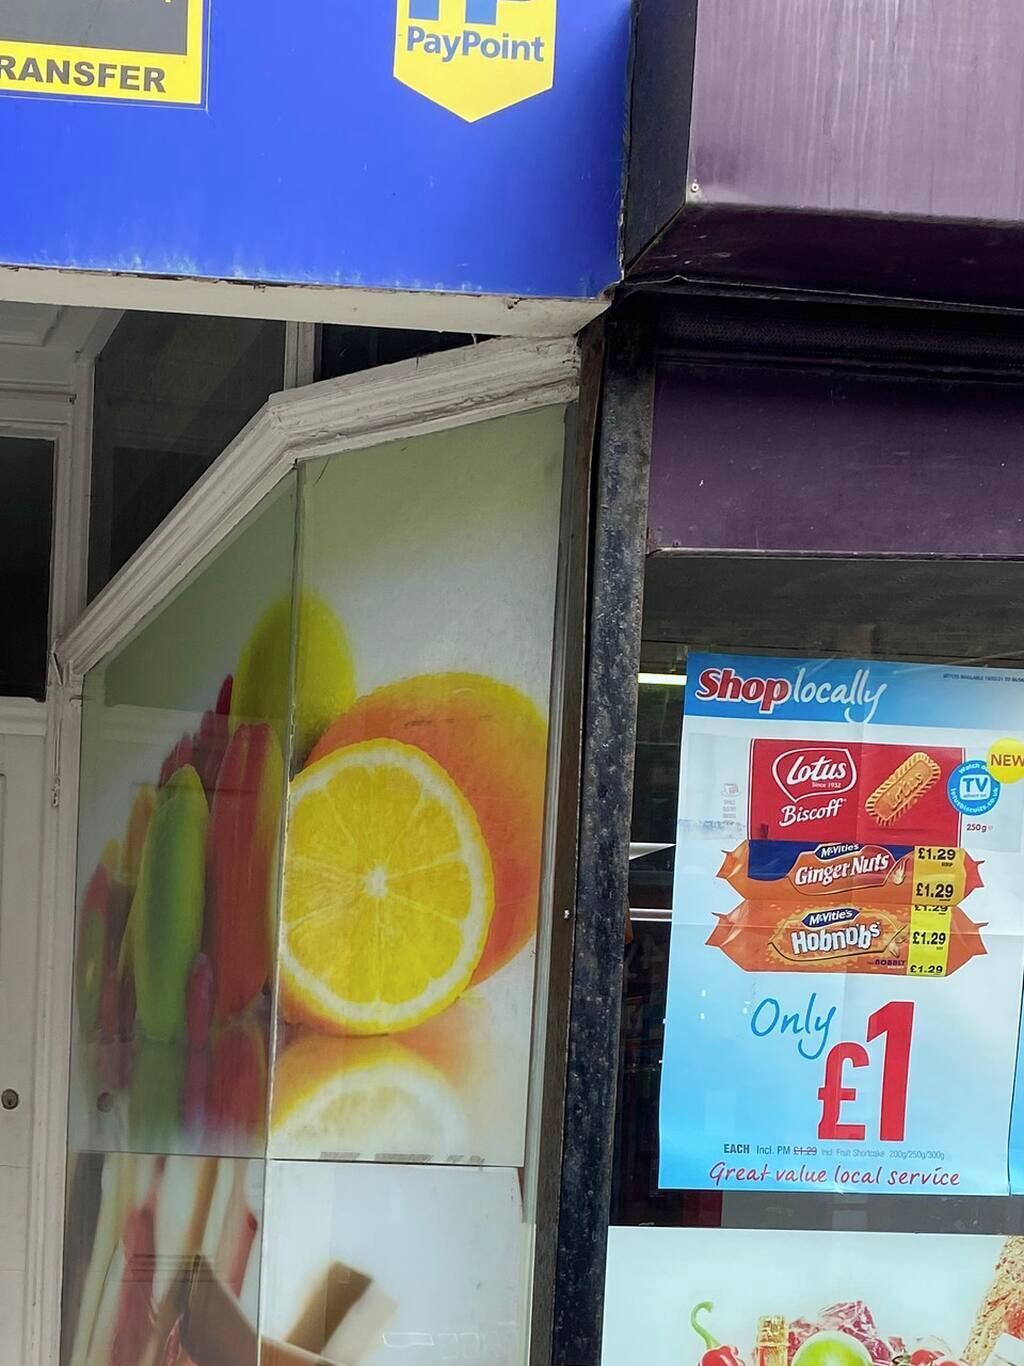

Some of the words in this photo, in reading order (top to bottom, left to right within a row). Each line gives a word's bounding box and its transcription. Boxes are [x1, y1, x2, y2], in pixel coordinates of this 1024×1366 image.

[406, 25, 545, 63] PayPoint
[786, 754, 847, 785] Lotus
[962, 777, 989, 793] TV
[779, 798, 843, 827] Biscoff
[966, 823, 987, 833] 250g
[917, 847, 956, 861] £1.29
[794, 861, 850, 887] Ginger
[851, 852, 890, 876] Nuts
[915, 882, 954, 898] £1.29
[790, 920, 880, 954] Hobnobs
[912, 931, 946, 945] £1.29
[909, 964, 943, 974] £1.29
[749, 992, 837, 1061] Only
[817, 1000, 916, 1143] £1
[723, 1143, 750, 1155] EACH
[777, 1145, 791, 1155] PM
[708, 1161, 770, 1187] Great
[775, 1163, 828, 1184] value
[833, 1165, 883, 1185] local
[887, 1167, 961, 1187] service
